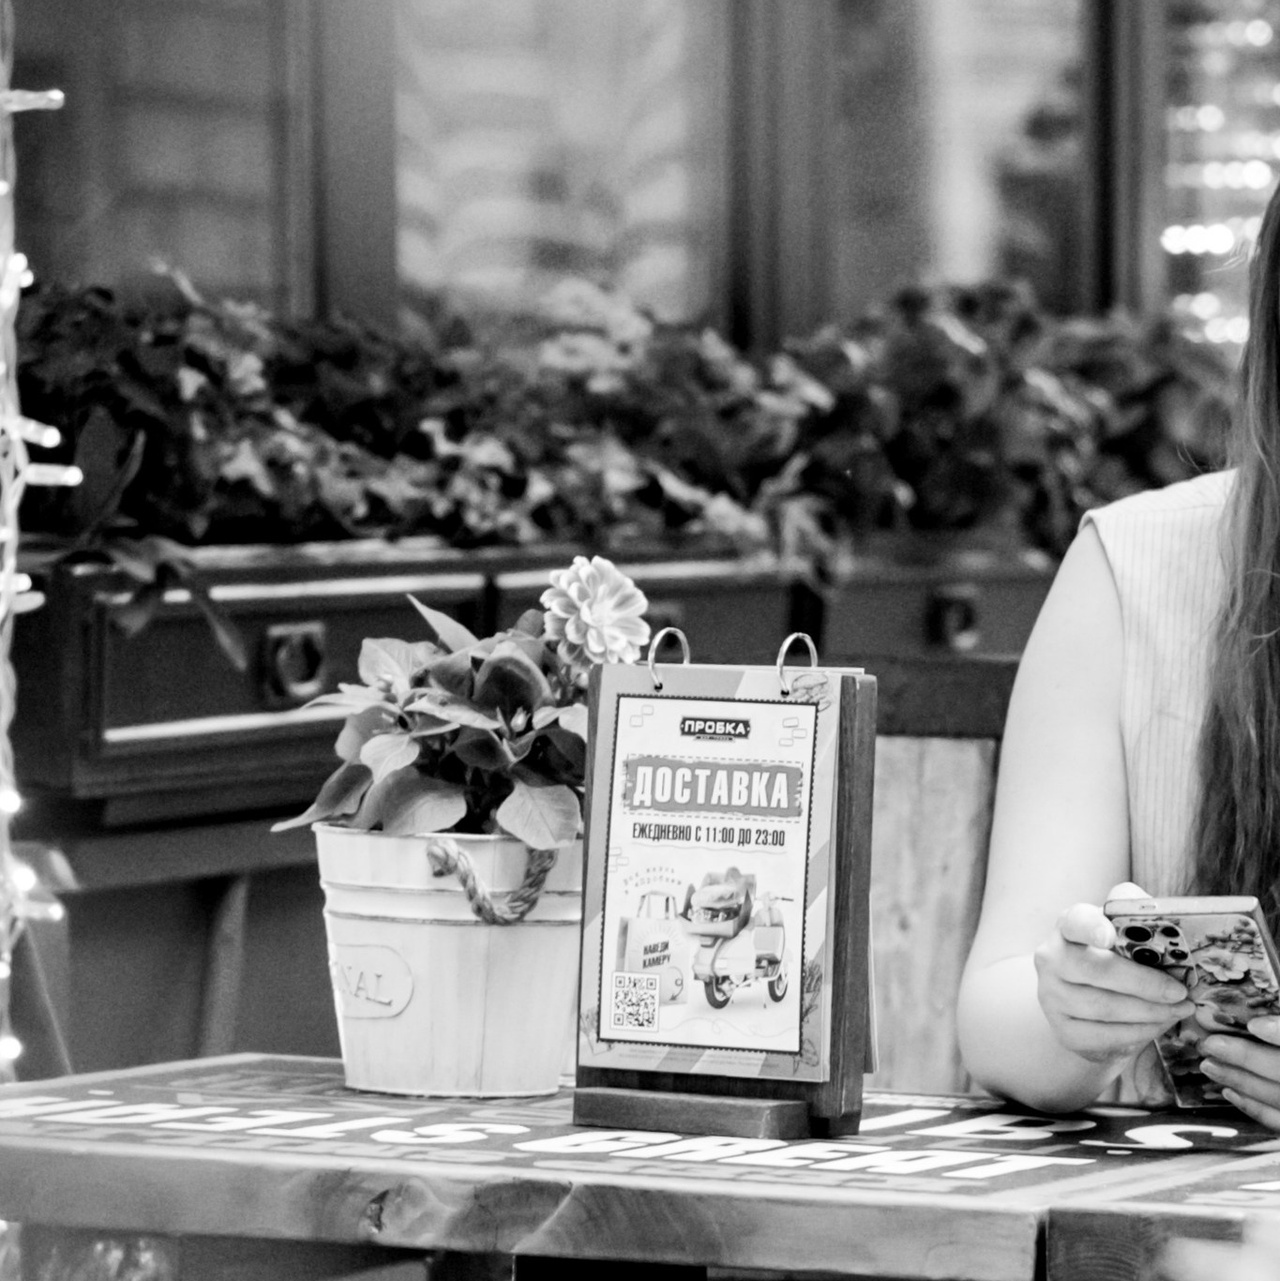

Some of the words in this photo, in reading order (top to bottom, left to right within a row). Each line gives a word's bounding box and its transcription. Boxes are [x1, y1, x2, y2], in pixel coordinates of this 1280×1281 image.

[684, 719, 746, 735] ПРОБКА
[633, 766, 789, 809] ДОСТАВКА
[632, 822, 692, 842] ЕЖЕДНЕВНО
[695, 825, 702, 842] С
[706, 827, 735, 844] 11:00
[737, 828, 752, 847] ДО
[755, 829, 786, 847] 23:00
